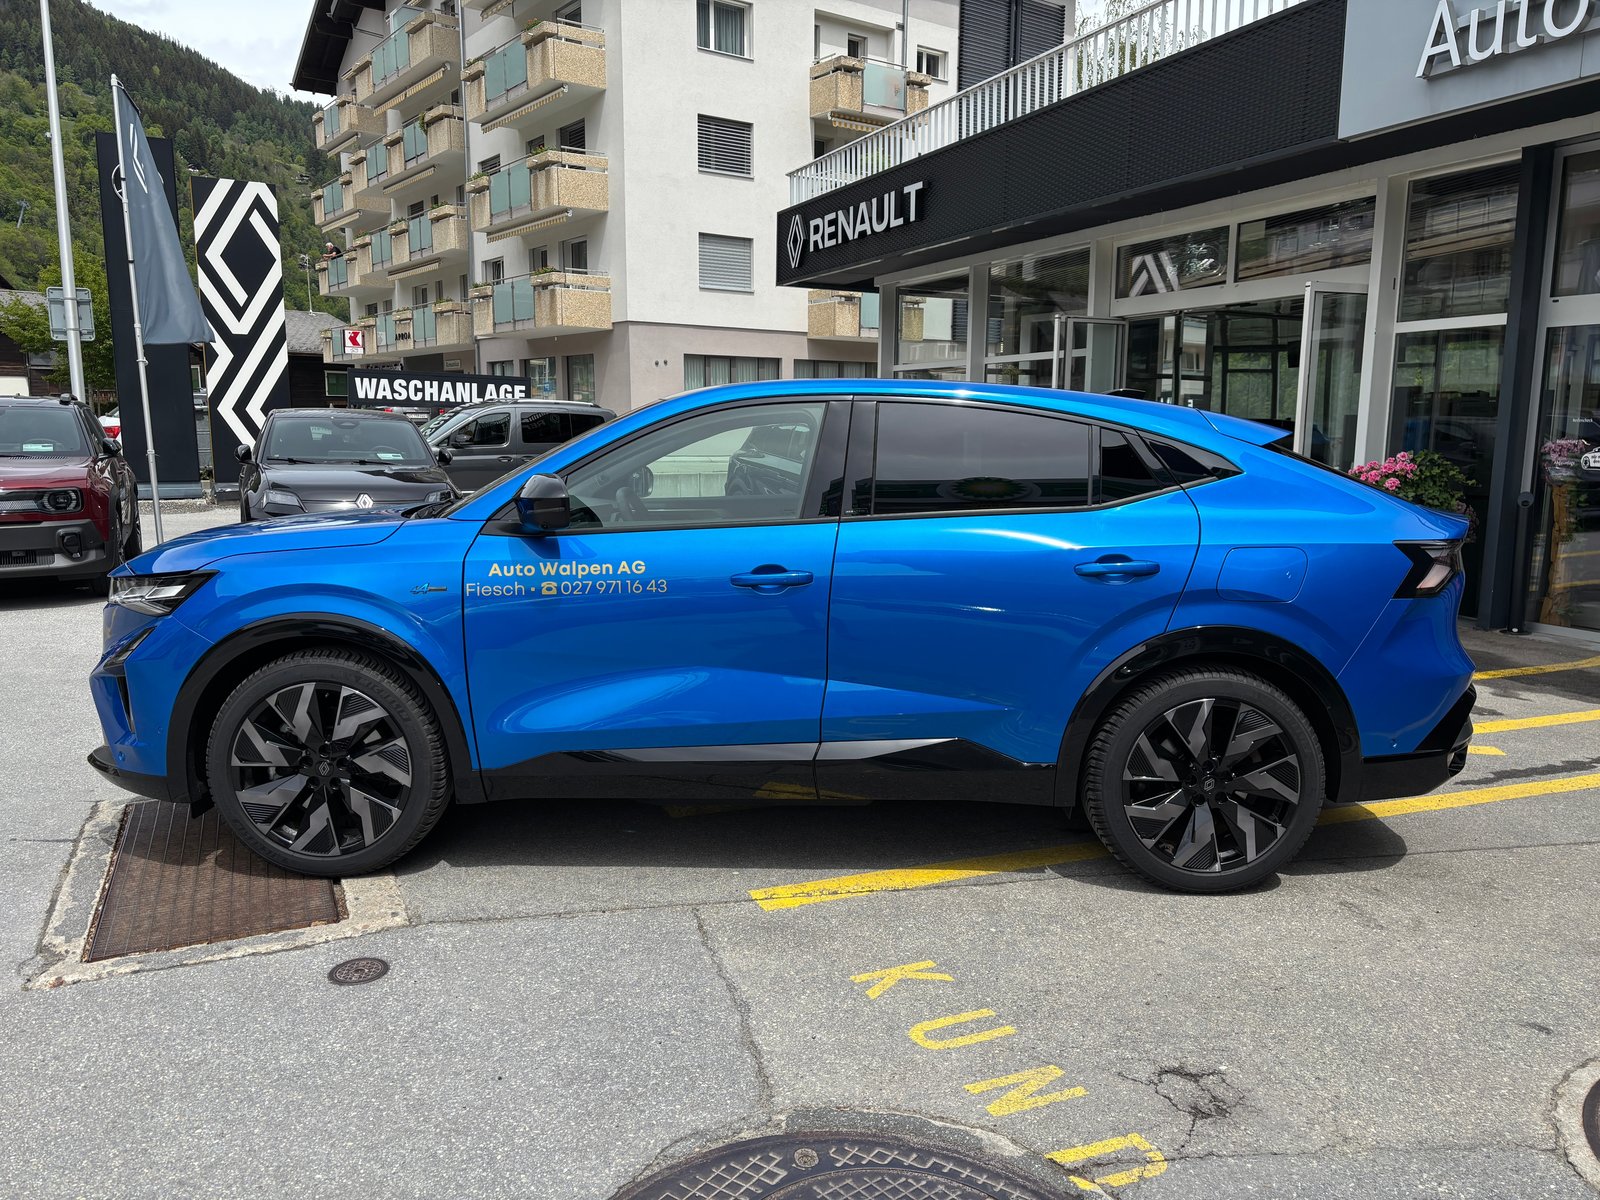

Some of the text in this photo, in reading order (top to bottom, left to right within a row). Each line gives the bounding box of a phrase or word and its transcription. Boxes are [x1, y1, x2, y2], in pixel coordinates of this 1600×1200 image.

[1415, 0, 1590, 79] Auto
[809, 181, 924, 253] RENAULT
[354, 377, 526, 403] WASCHANLAGE
[488, 560, 646, 578] Auto Walpen AG
[466, 581, 525, 597] Fiesch
[560, 581, 593, 595] 027
[646, 579, 667, 593] 43
